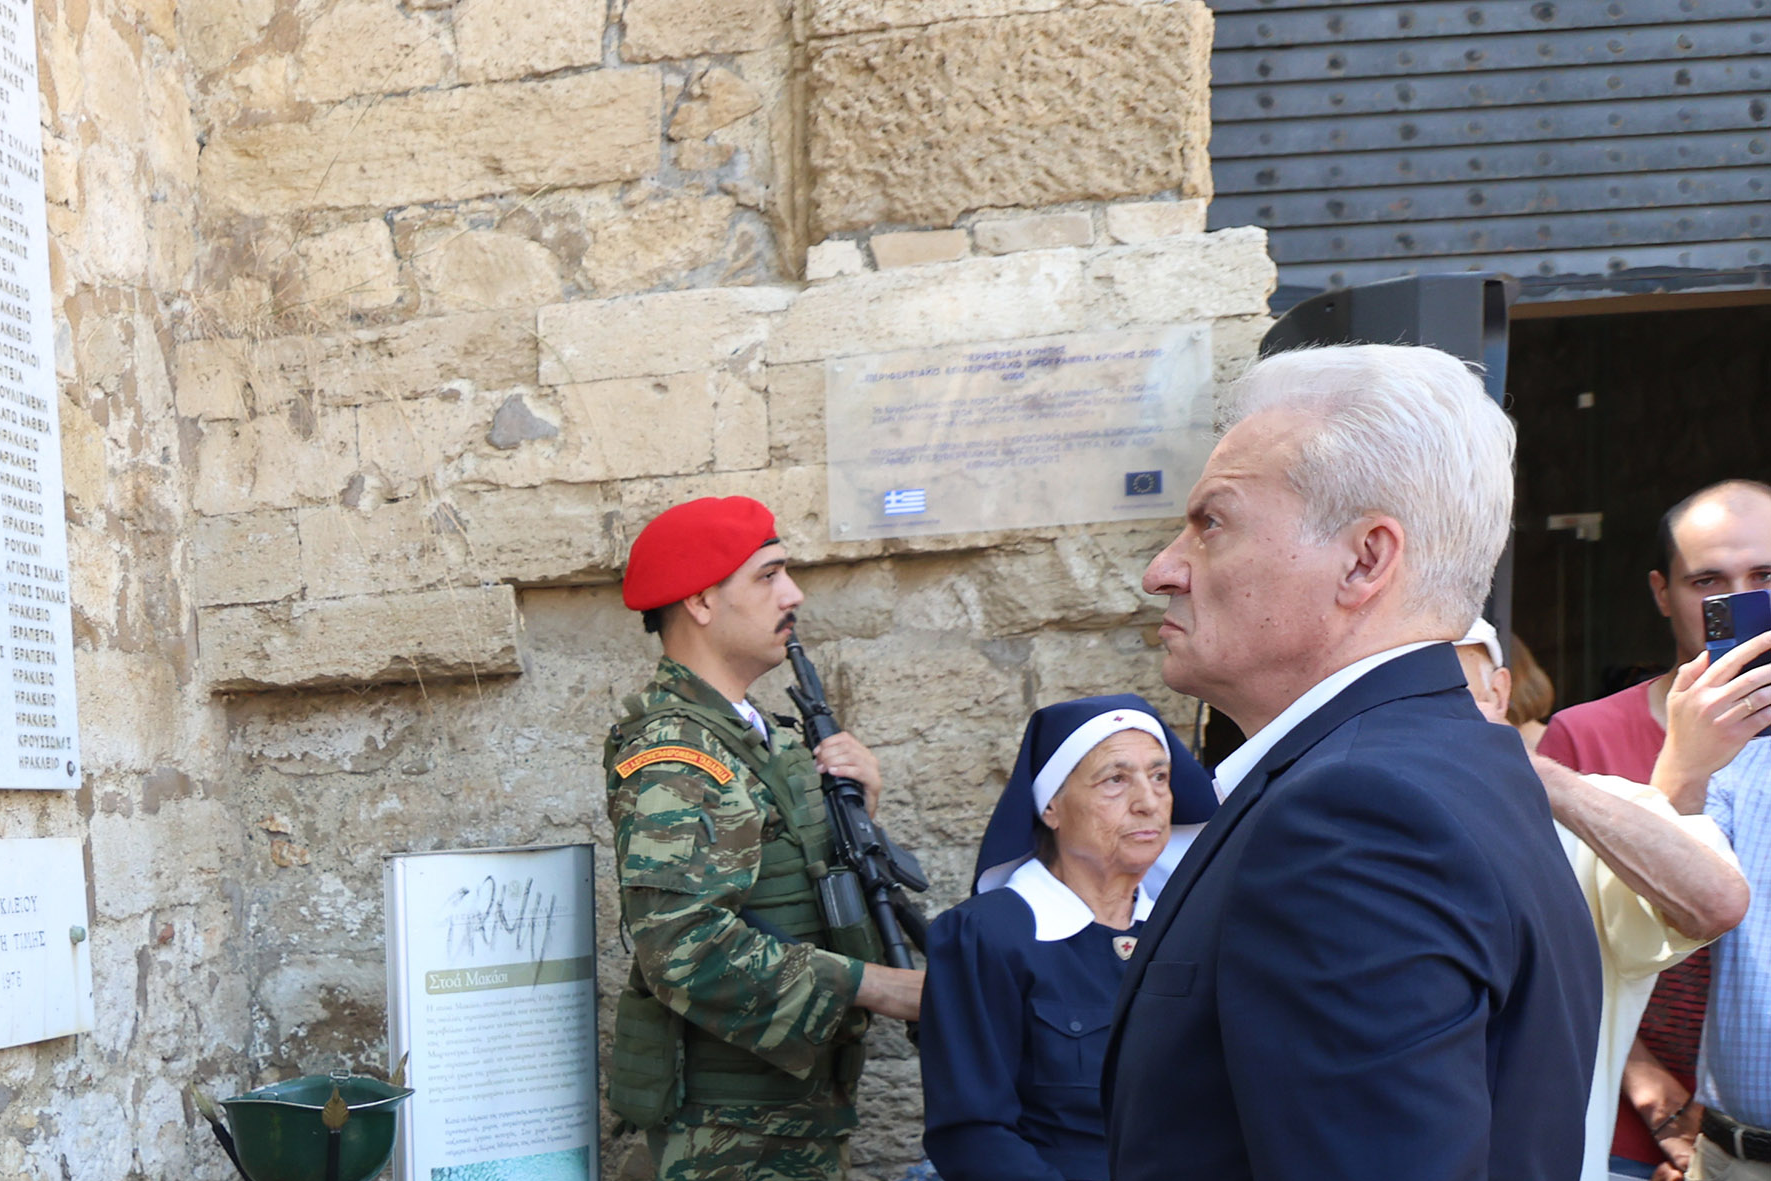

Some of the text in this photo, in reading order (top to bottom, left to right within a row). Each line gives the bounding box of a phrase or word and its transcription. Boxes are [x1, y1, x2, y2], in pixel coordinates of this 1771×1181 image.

[13, 930, 46, 950] ΤΙΜΗΣ
[429, 970, 508, 990] Στοά Μακάσι
